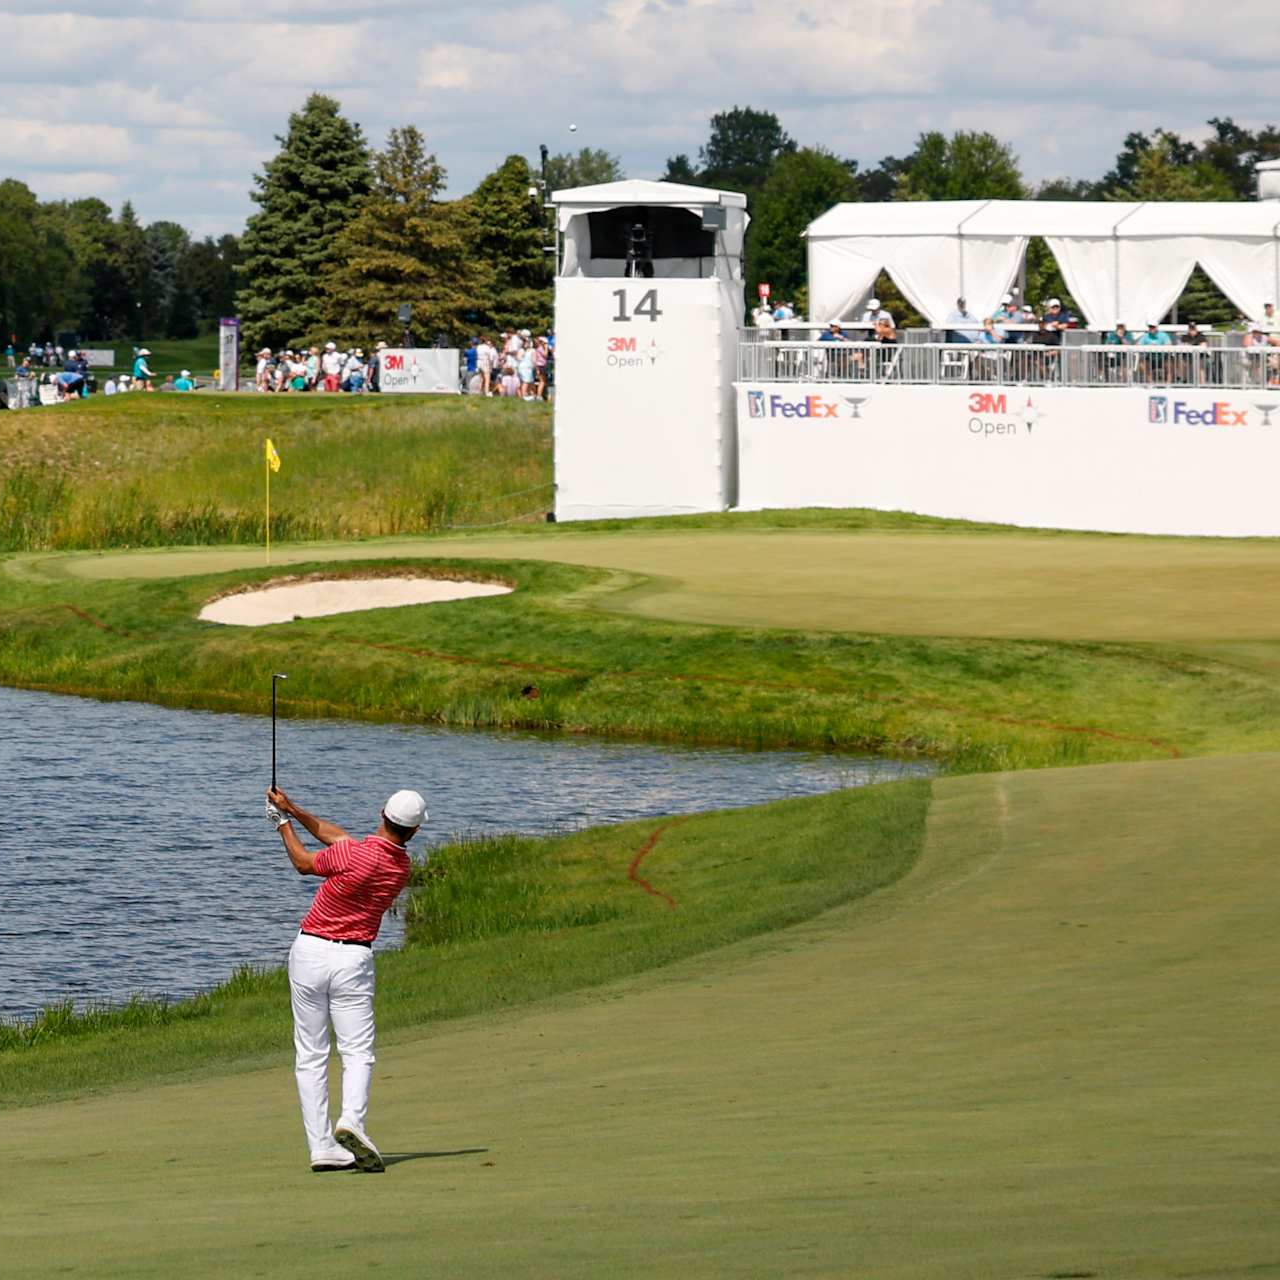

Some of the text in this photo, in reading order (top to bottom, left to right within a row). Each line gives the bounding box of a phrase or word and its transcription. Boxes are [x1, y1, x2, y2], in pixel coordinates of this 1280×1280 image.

[612, 288, 663, 322] 14
[607, 337, 637, 352] 3M
[384, 355, 404, 370] 3M
[606, 354, 643, 368] Open
[384, 373, 408, 388] Open
[770, 395, 838, 418] FedEx
[968, 393, 1006, 413] 3M
[1174, 402, 1248, 425] FedEx
[968, 417, 1017, 437] Open
